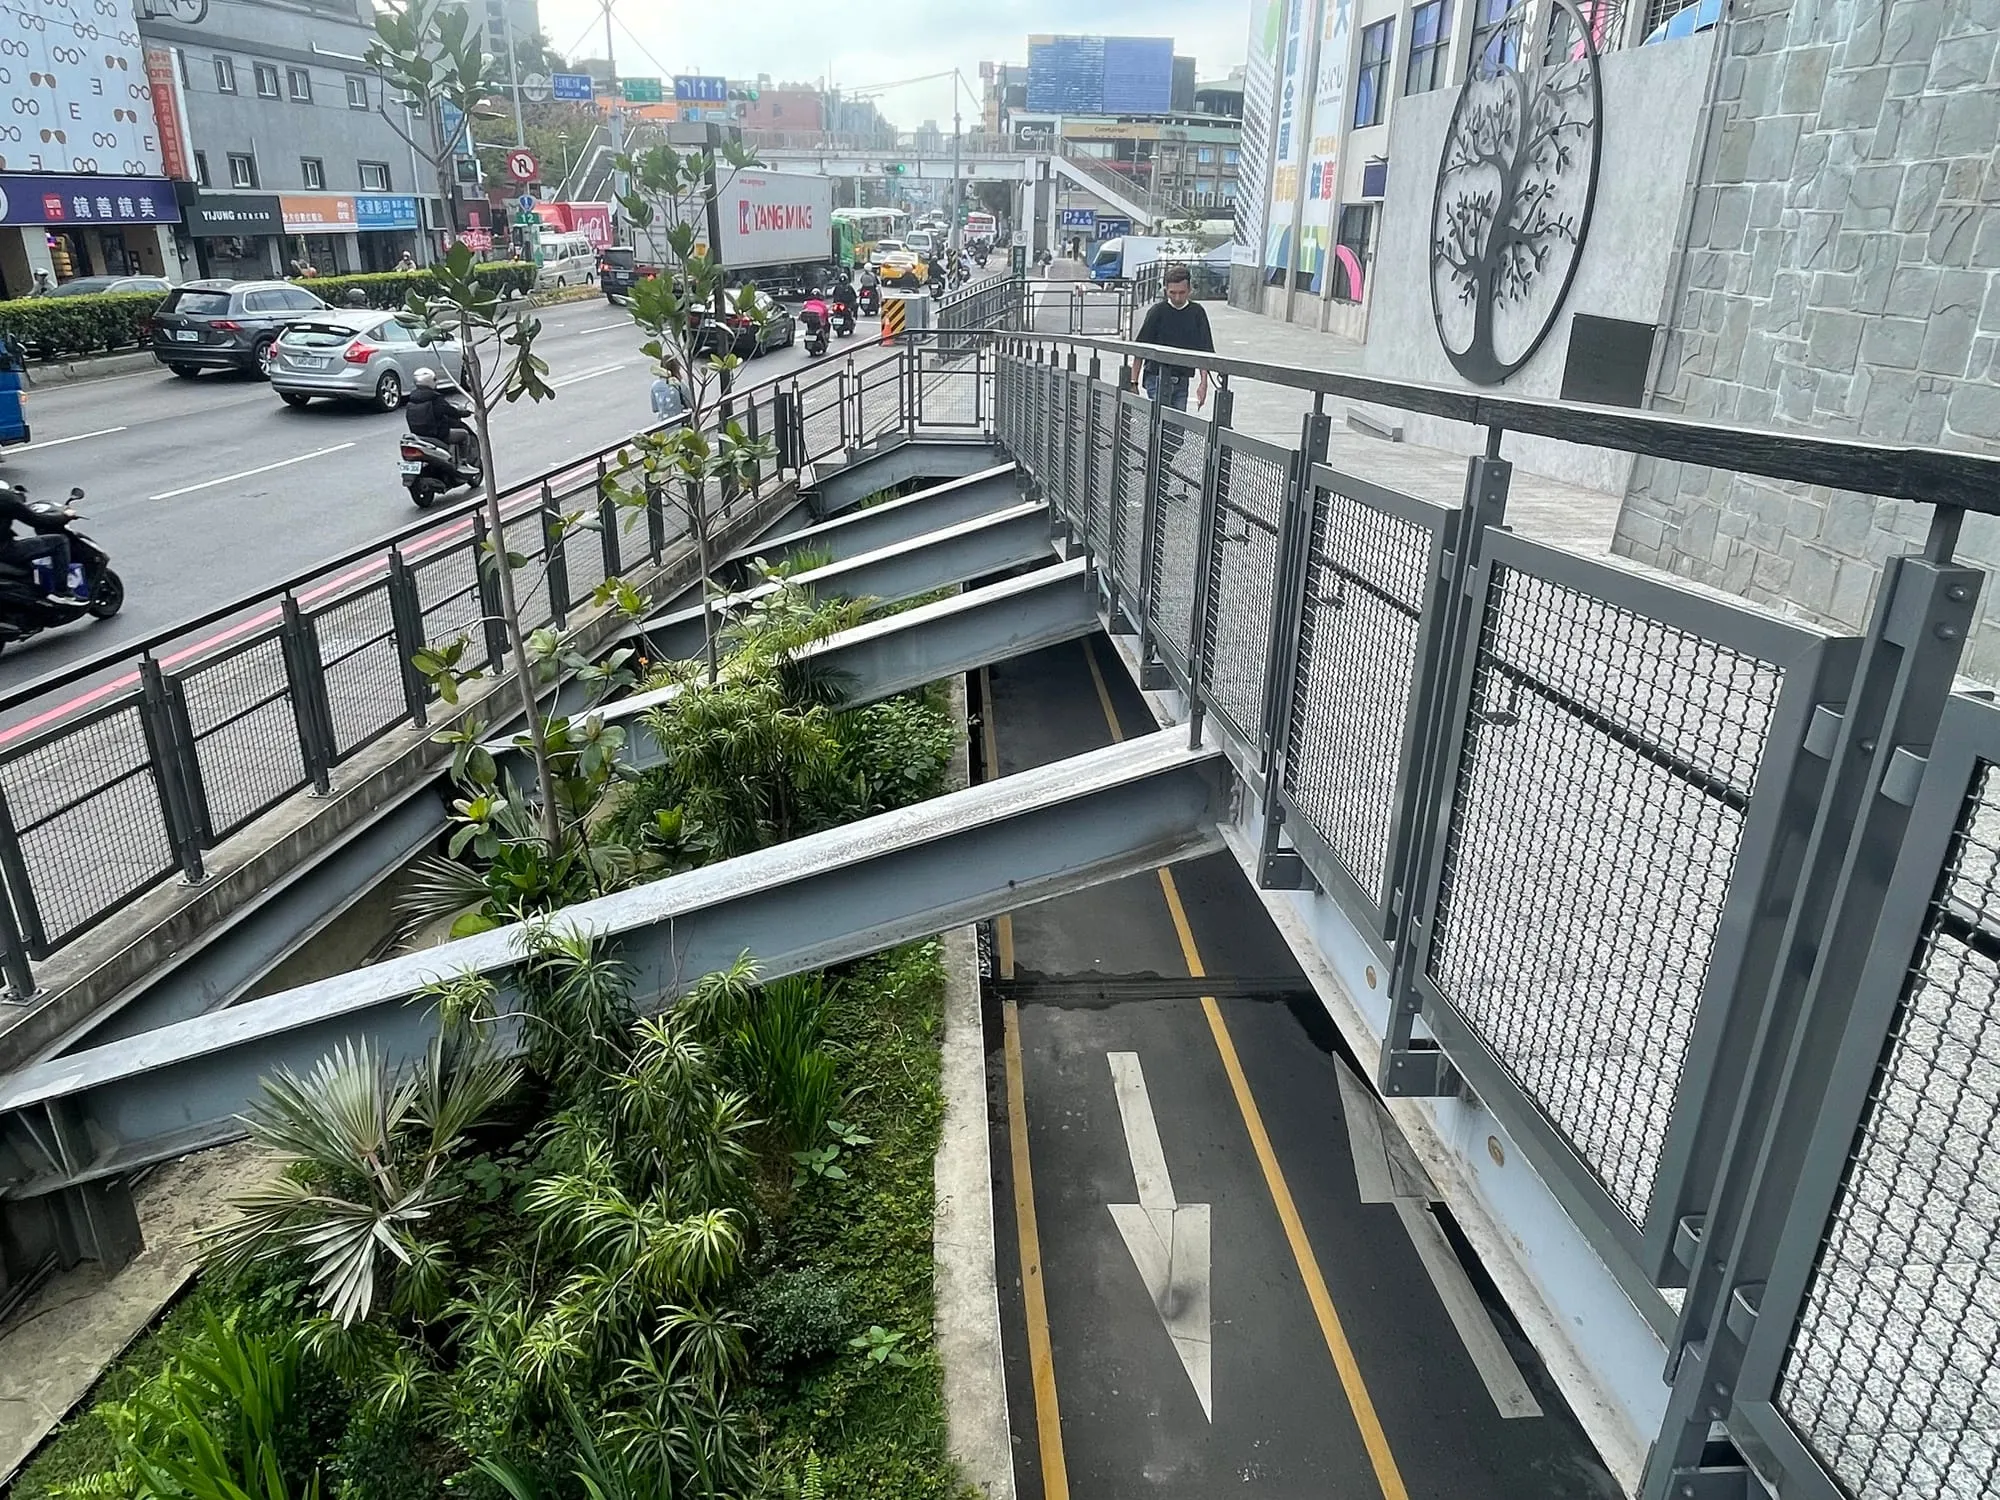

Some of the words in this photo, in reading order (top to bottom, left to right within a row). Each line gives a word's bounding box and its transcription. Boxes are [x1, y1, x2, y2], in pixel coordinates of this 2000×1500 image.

[72, 196, 157, 218] 鏡善鏡美
[201, 210, 235, 222] YIJUNG
[521, 213, 535, 223] 12
[752, 204, 783, 231] YANG
[785, 205, 813, 231] MING
[1063, 211, 1072, 224] P
[1099, 222, 1108, 238] P
